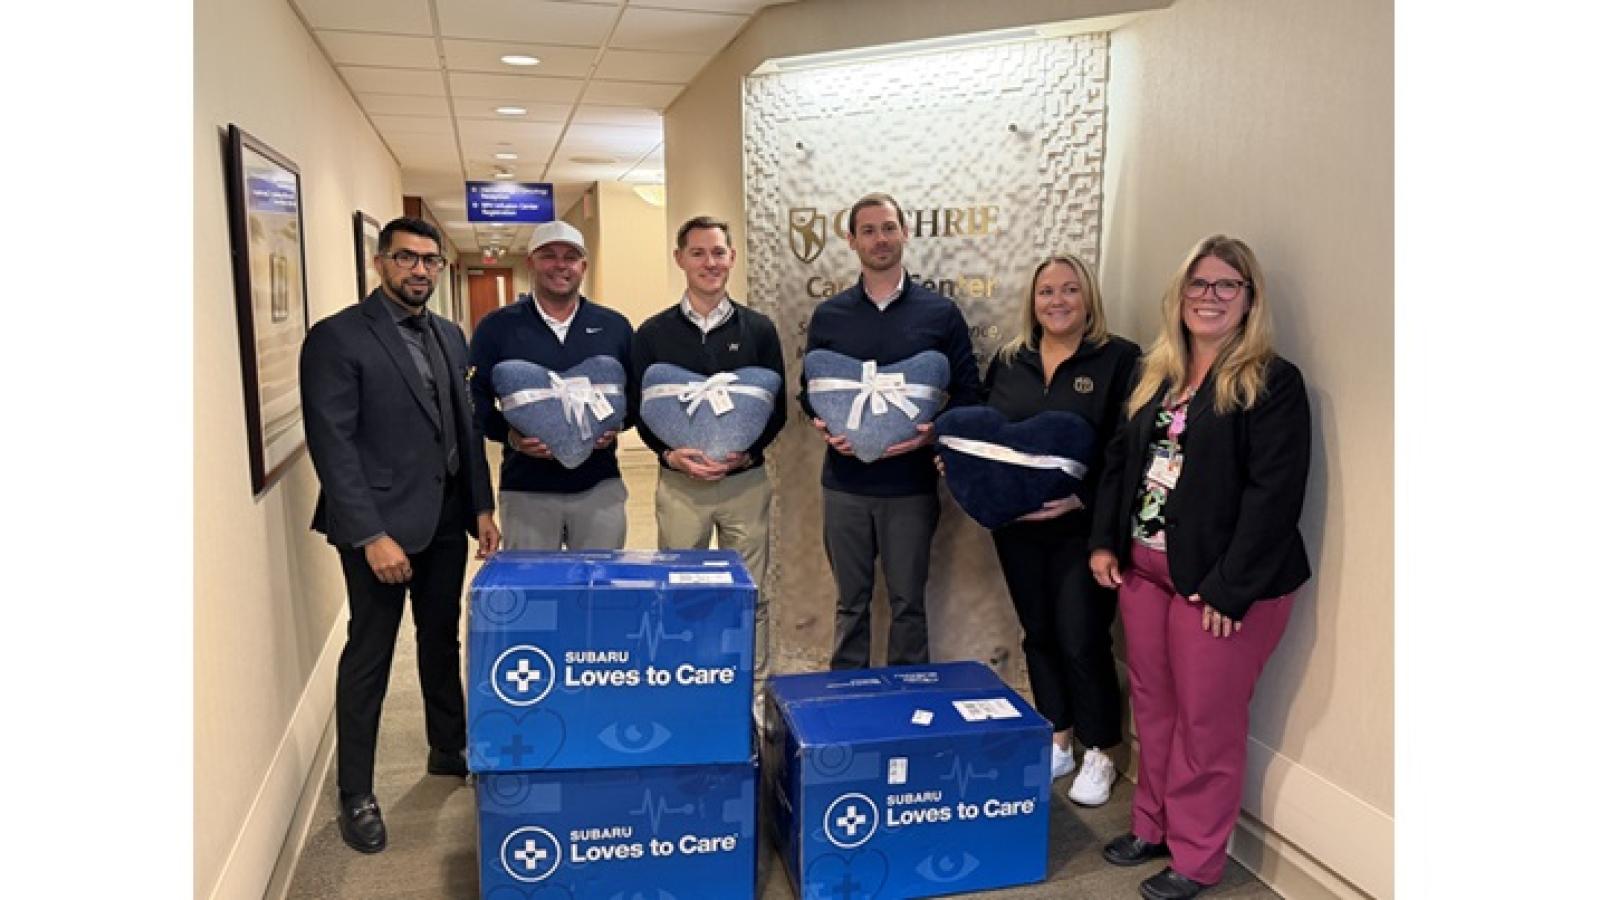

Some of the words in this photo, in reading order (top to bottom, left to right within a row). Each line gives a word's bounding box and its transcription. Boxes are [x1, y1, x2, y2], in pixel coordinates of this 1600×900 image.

[909, 272, 998, 298] enter
[565, 651, 630, 664] SUBARU
[564, 665, 641, 687] Loves
[646, 665, 671, 686] to
[675, 663, 736, 685] Care
[887, 790, 942, 806] SUBARU
[887, 807, 952, 827] Loves
[957, 802, 980, 820] to
[983, 797, 1035, 818] Care
[570, 826, 632, 841] SUBARU
[570, 842, 644, 863] Loves
[649, 838, 674, 856] to
[678, 833, 738, 854] Care
